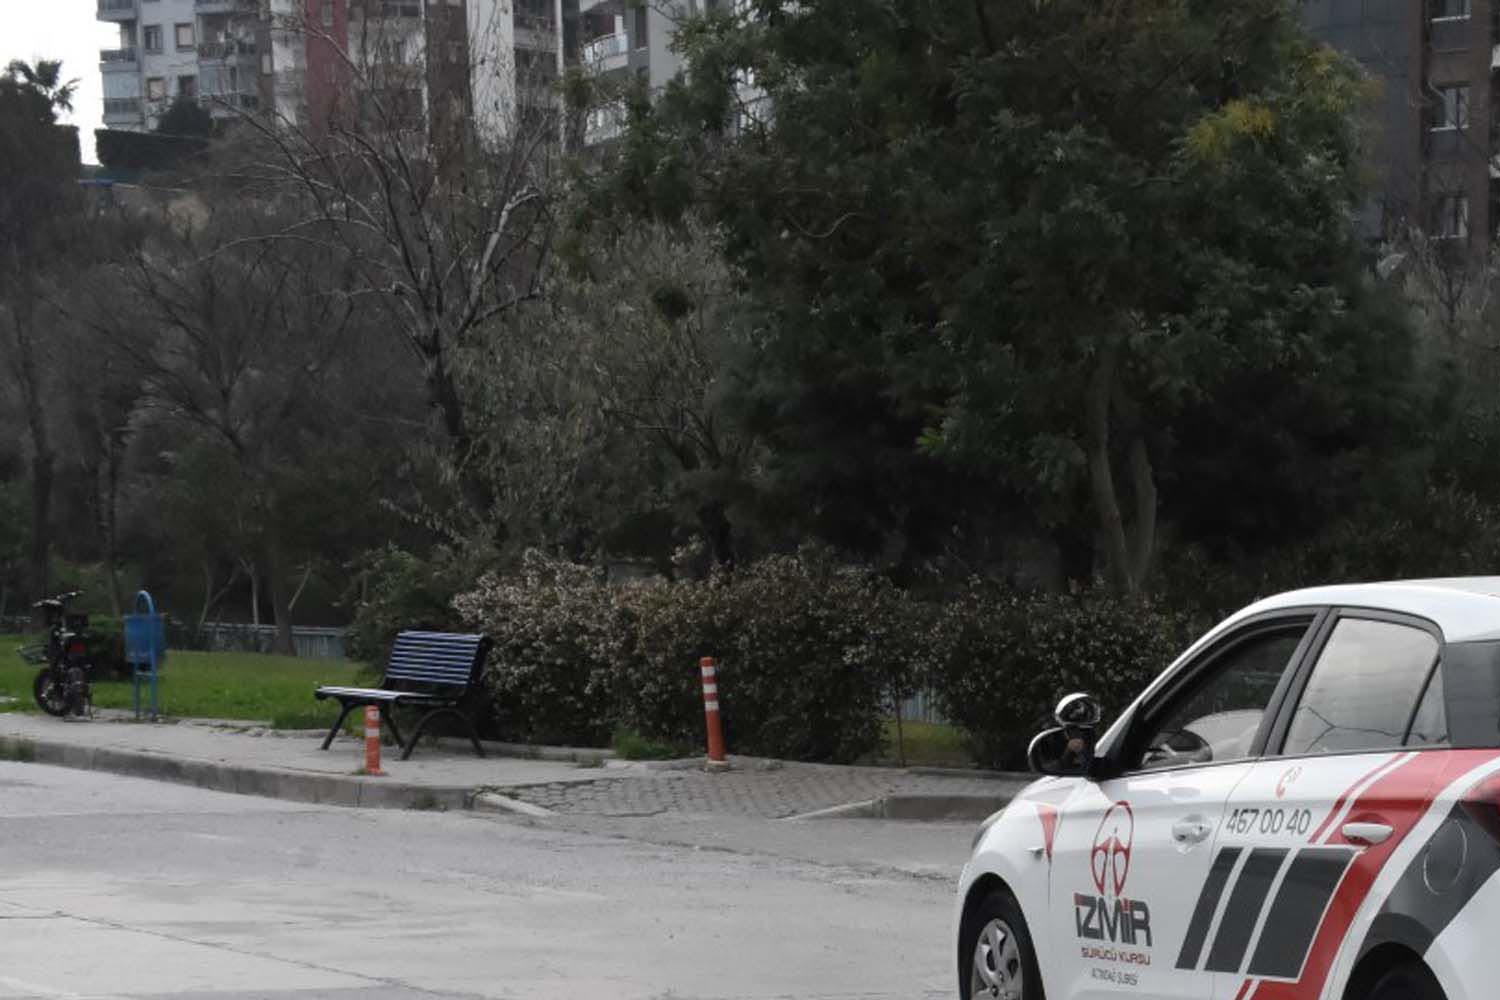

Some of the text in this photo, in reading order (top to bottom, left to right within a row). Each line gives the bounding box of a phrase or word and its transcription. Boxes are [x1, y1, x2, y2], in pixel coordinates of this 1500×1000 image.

[1226, 809, 1311, 835] 467 00 40
